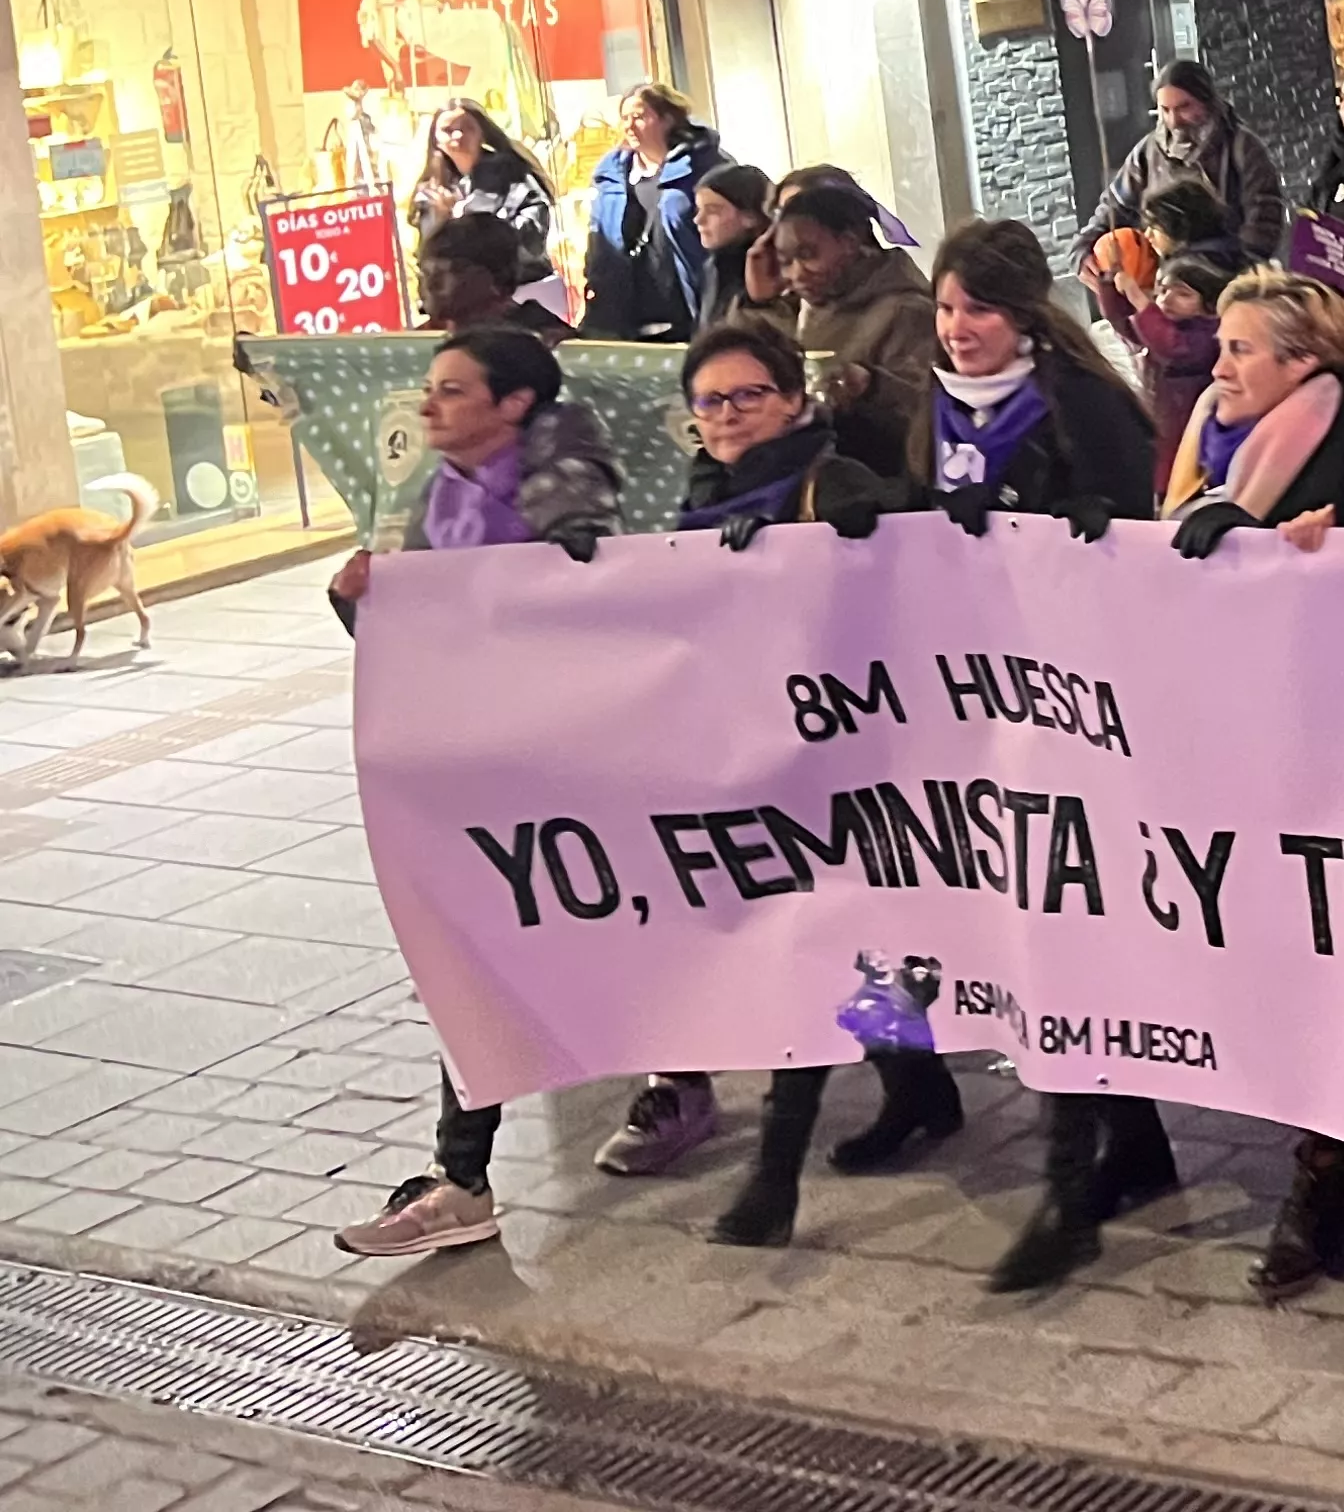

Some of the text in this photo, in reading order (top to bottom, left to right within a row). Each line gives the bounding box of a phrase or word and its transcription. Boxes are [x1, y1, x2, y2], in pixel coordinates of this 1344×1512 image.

[276, 202, 384, 234] DÍAS OUTLET
[785, 653, 1133, 759] 8M HUESCA
[465, 815, 652, 928] YO,
[649, 779, 1106, 918] FEMINISTA
[1138, 820, 1236, 949] ¿Y
[1039, 1014, 1093, 1055] 8M
[1103, 1017, 1218, 1071] HUESCA
